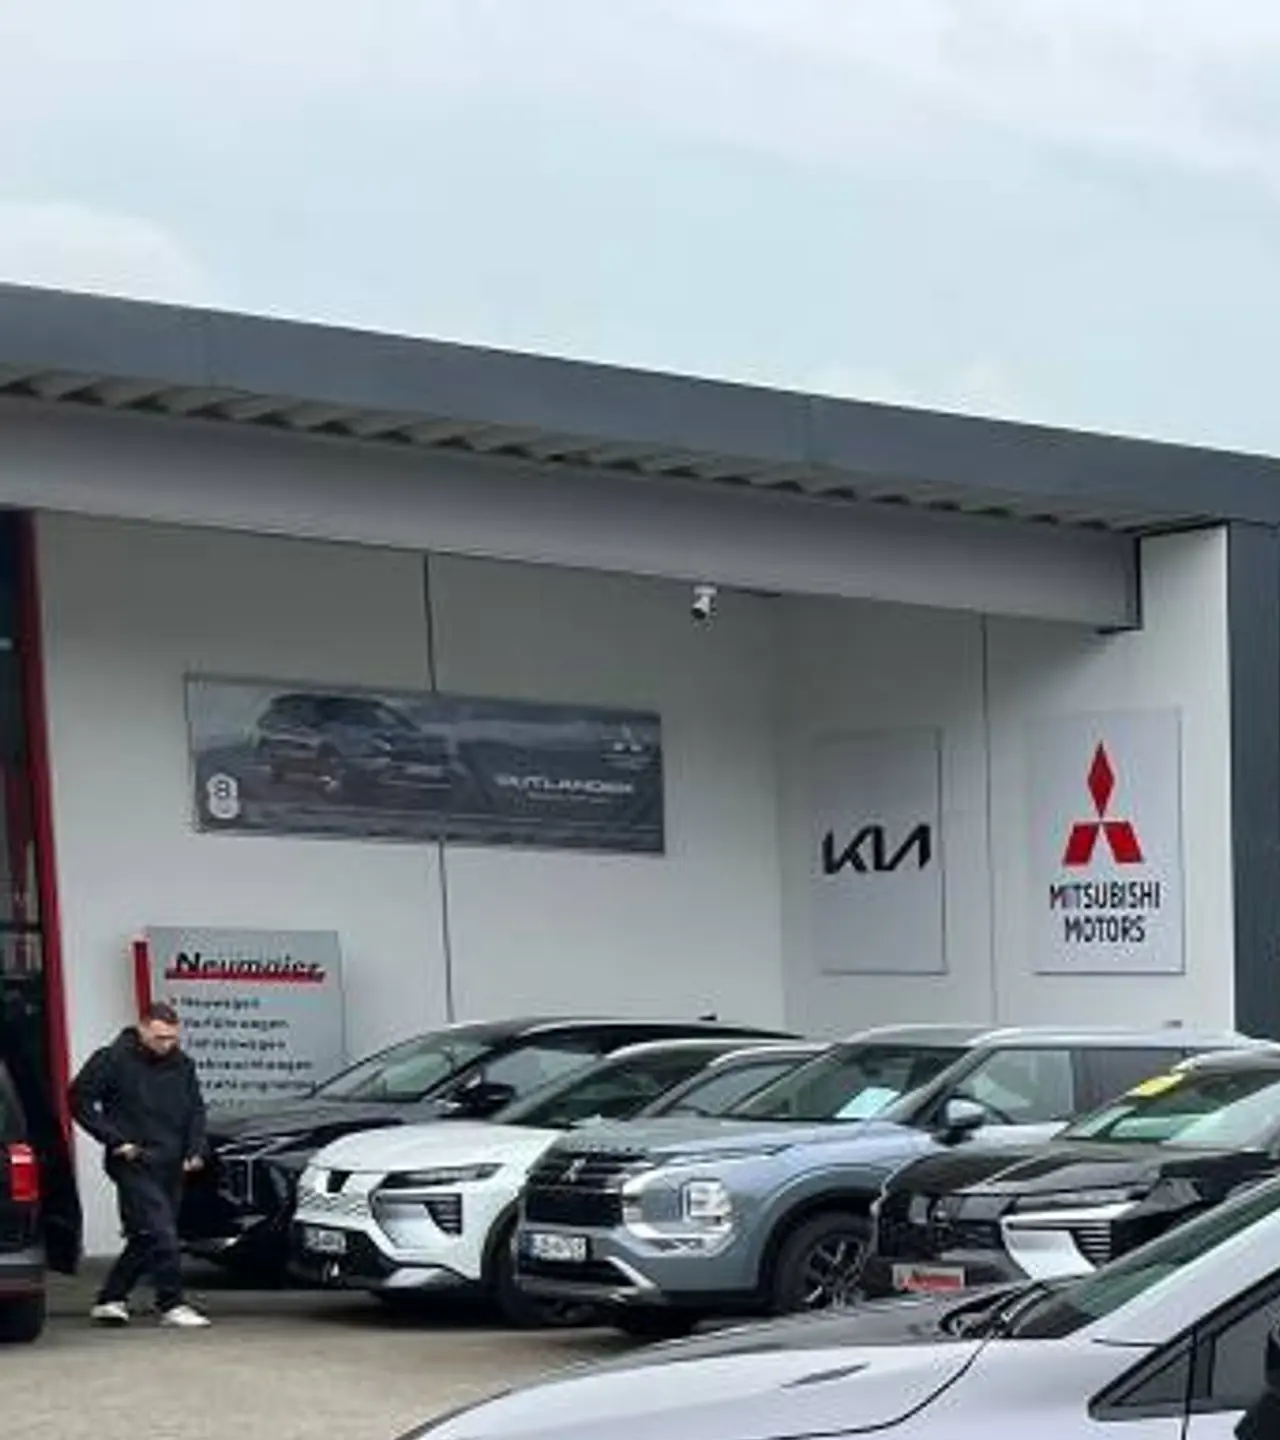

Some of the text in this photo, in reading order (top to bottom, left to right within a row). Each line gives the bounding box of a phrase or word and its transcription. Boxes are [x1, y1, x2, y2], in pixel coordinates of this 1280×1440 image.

[822, 825, 931, 874] KIA
[1049, 881, 1160, 909] MITSUBISHI
[1064, 914, 1145, 942] MOTORS
